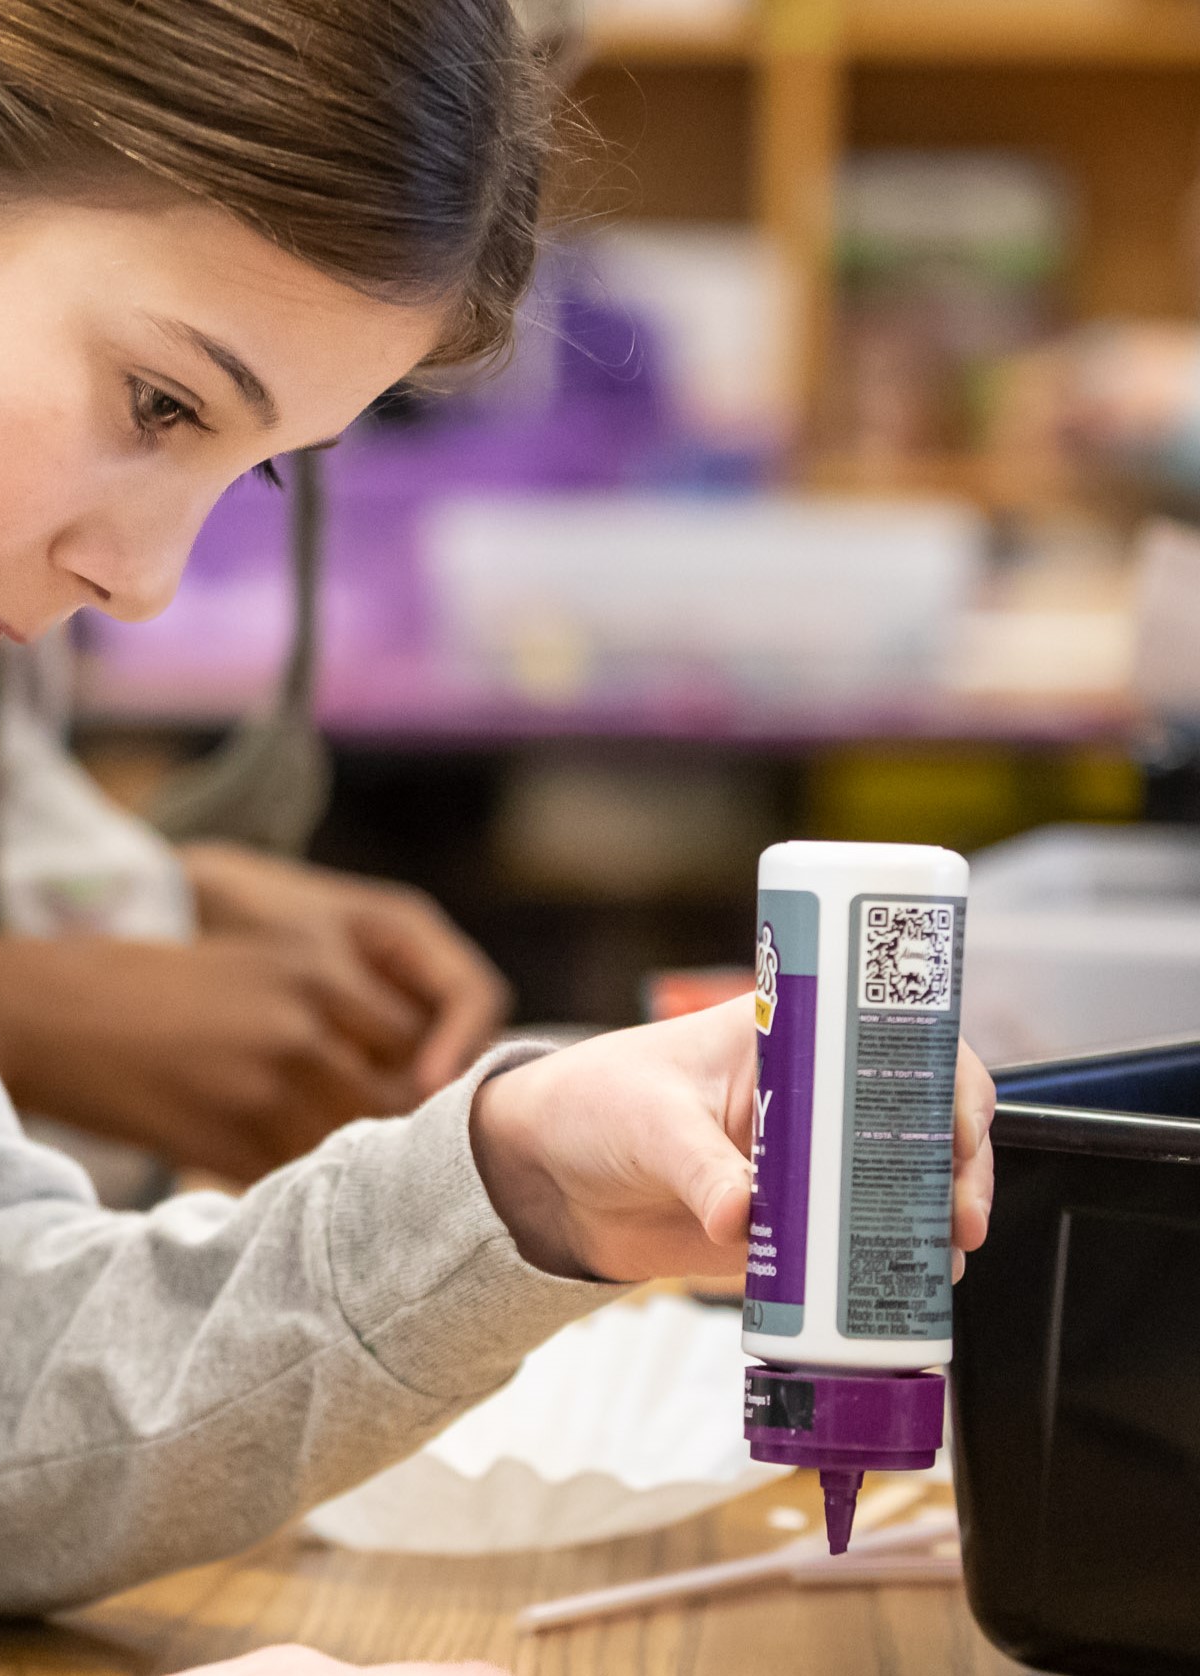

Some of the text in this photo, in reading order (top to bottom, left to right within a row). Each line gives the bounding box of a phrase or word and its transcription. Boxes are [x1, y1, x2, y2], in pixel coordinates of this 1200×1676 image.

[850, 1233, 912, 1249] Manufactured
[848, 1308, 874, 1321] Made
[847, 1322, 876, 1335] Hecho
